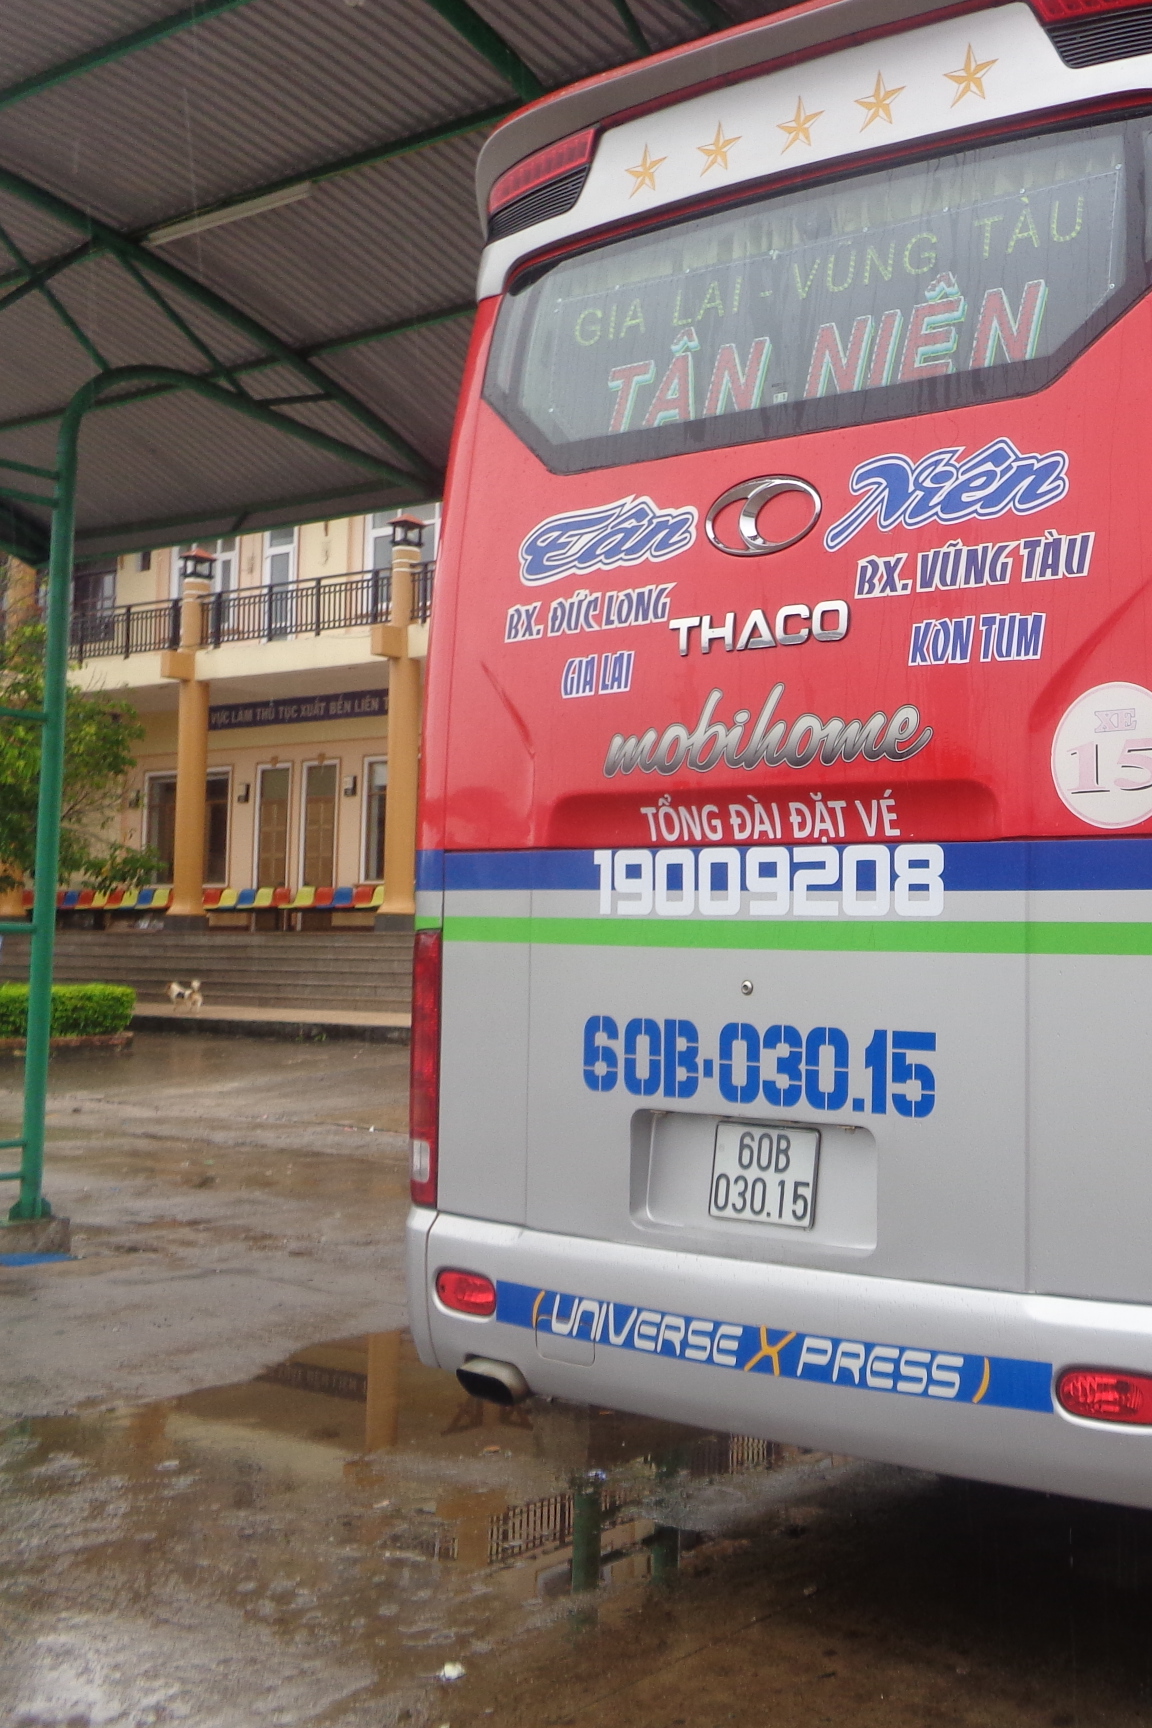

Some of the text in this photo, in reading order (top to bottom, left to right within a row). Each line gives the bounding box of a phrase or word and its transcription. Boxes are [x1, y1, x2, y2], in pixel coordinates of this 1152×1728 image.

[575, 299, 645, 346] GIA
[672, 276, 743, 326] LAI
[607, 271, 1049, 433] TÂN NIÊN
[916, 539, 1020, 592] VŨNG
[1020, 530, 1095, 582] TÀU
[548, 589, 602, 637] ĐỨC
[602, 583, 677, 630] LONG
[669, 600, 848, 656] THACO
[908, 613, 1046, 666] KON TUM
[562, 651, 635, 698] GIA LAI
[604, 682, 933, 778] mobihome
[1094, 708, 1137, 733] XE
[640, 789, 900, 843] TỔNG ĐÀI ĐẶT VÉ
[594, 844, 944, 916] 19009208
[738, 1131, 791, 1174] 60B
[714, 1173, 810, 1221] 030.15
